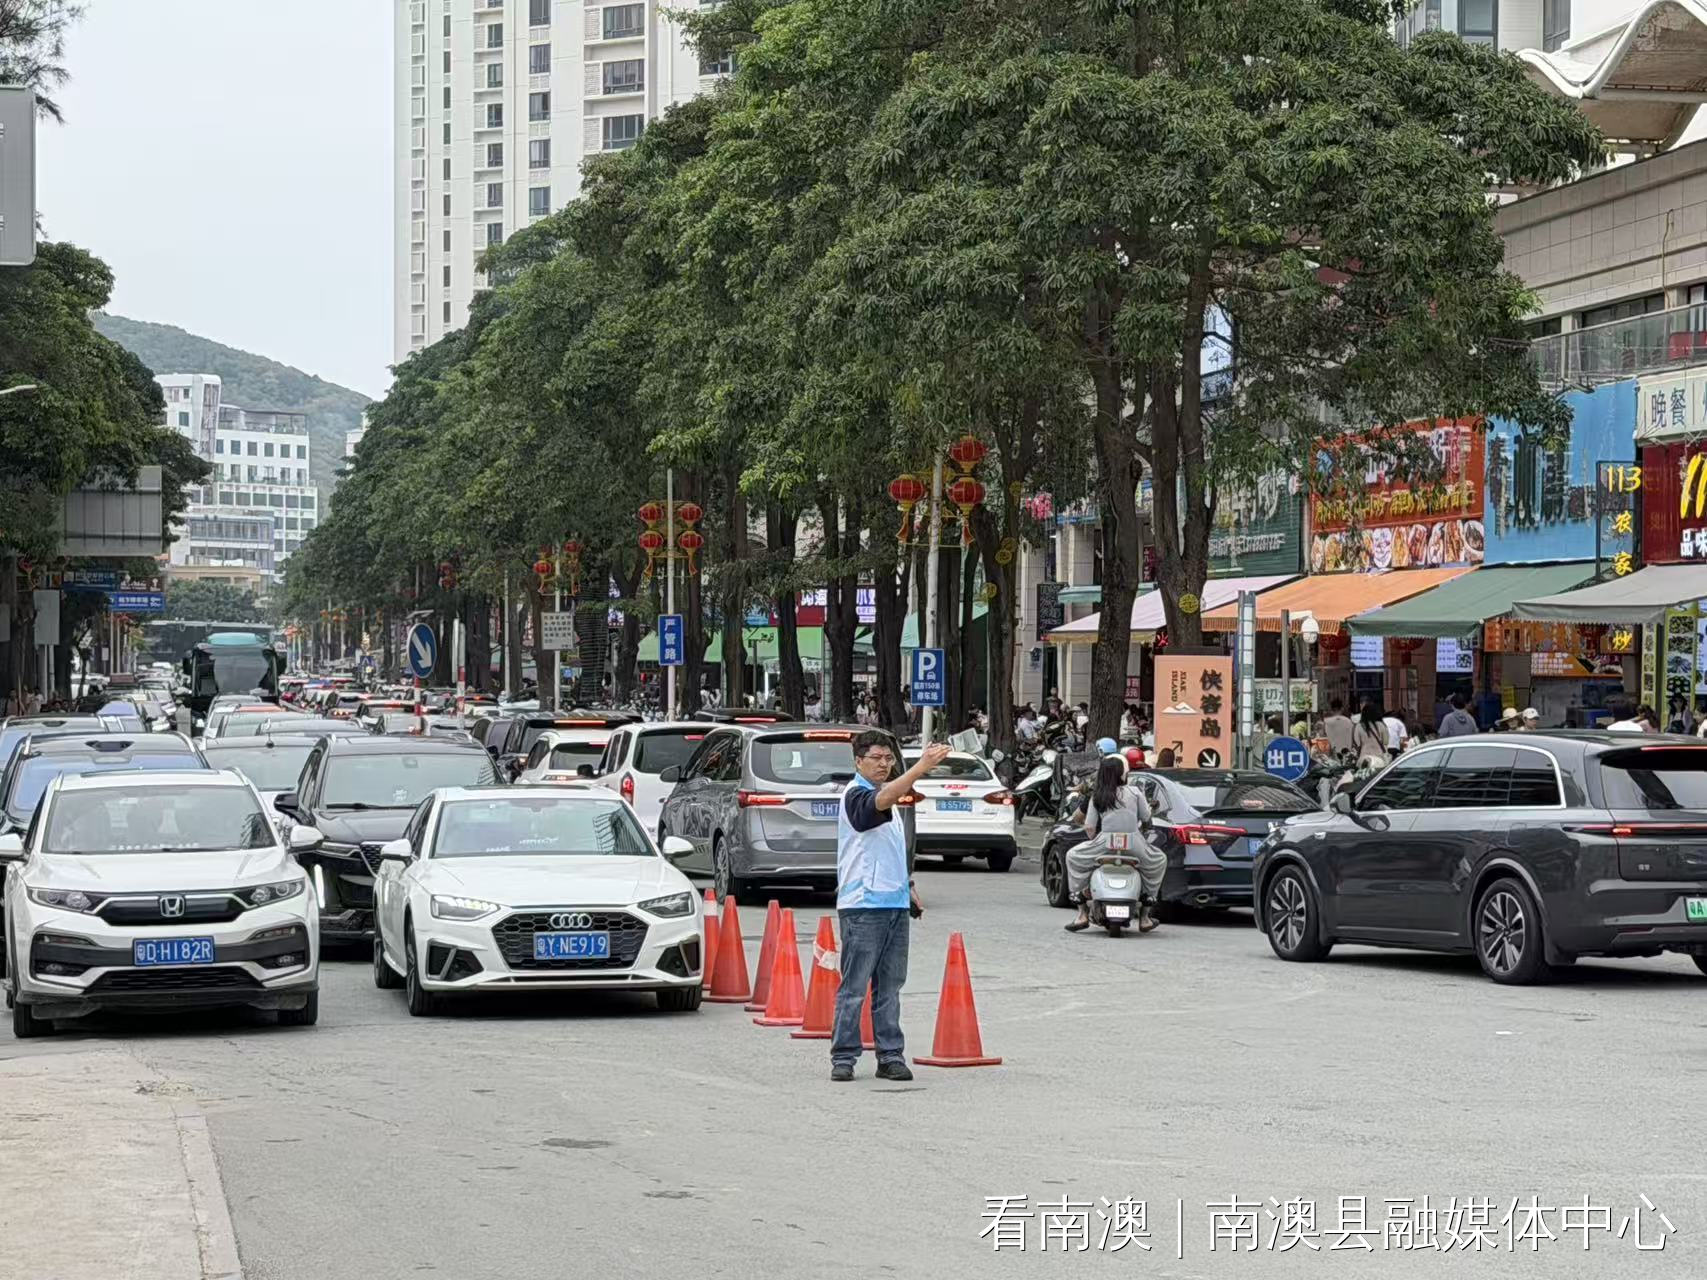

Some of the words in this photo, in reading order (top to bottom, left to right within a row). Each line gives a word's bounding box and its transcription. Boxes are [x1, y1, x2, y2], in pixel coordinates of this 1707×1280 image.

[1651, 387, 1687, 428] 晚餐
[1608, 464, 1642, 493] 113
[665, 619, 676, 660] 严管路
[918, 651, 937, 681] P
[1267, 749, 1304, 769] 出口
